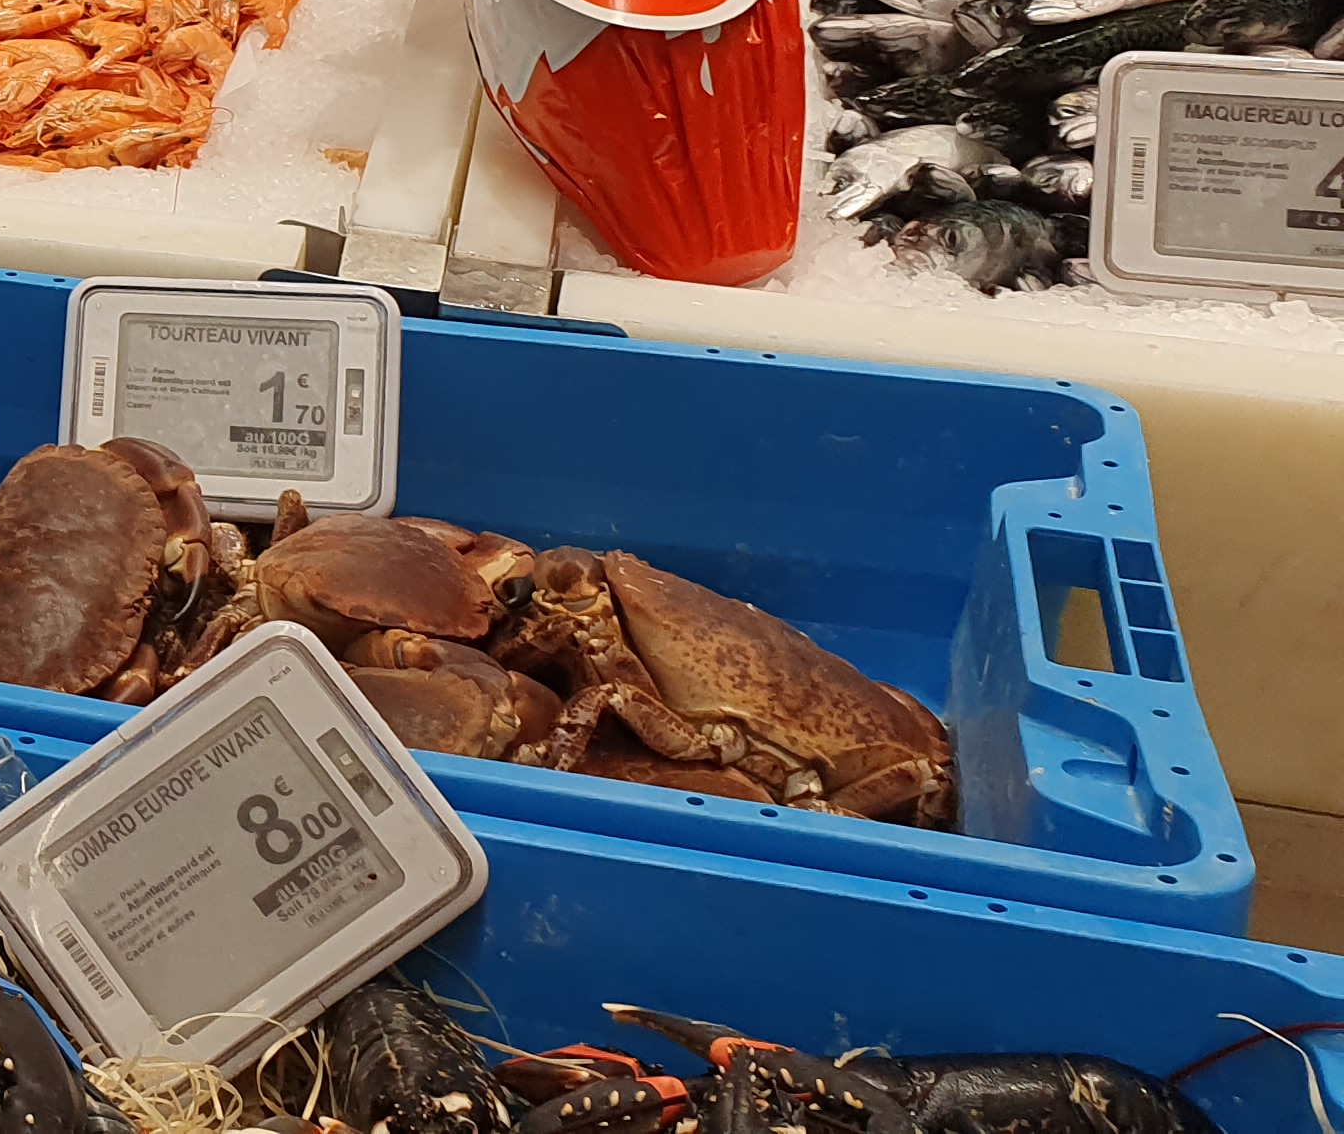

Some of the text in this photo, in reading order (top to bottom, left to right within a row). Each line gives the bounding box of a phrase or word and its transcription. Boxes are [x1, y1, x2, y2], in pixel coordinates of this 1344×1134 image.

[1185, 103, 1312, 127] MAQUEREAU
[148, 324, 311, 348] TOURTEAU VIVANT
[258, 371, 285, 423] 1
[295, 404, 326, 426] 70
[244, 431, 311, 446] au 100G
[61, 713, 269, 880] HOMARD EUROPE VIVANT
[236, 794, 304, 865] 8
[300, 801, 342, 840] 00
[173, 856, 199, 879] nord
[275, 880, 299, 905] au
[299, 844, 348, 883] 100G
